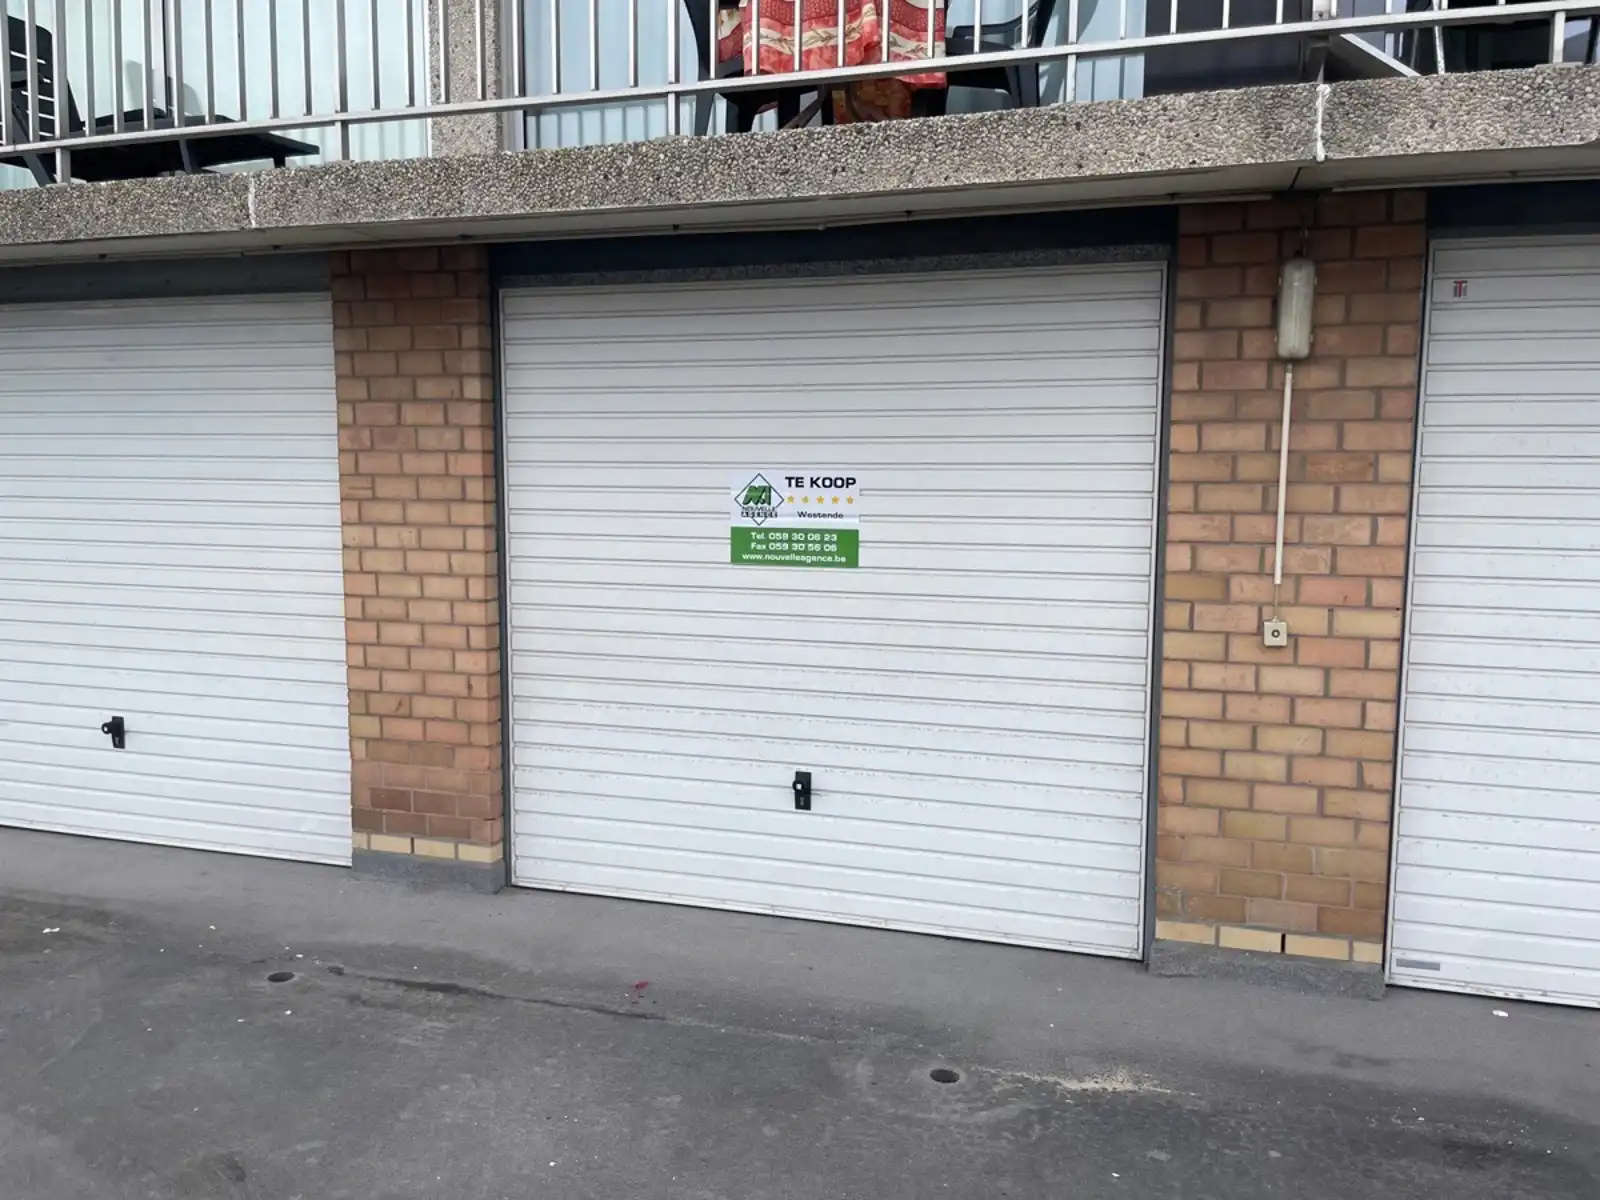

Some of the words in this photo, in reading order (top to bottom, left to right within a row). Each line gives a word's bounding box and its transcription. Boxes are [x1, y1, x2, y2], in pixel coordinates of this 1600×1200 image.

[785, 476, 805, 488] TE
[810, 476, 857, 489] KOOP
[797, 511, 844, 519] Westende
[768, 533, 789, 541] 059
[791, 533, 805, 541] 30
[823, 534, 838, 542] 23
[750, 542, 766, 550] Fax
[768, 543, 789, 551] 059
[791, 543, 805, 552] 30
[742, 553, 847, 563] www.nouvelleagence.be
